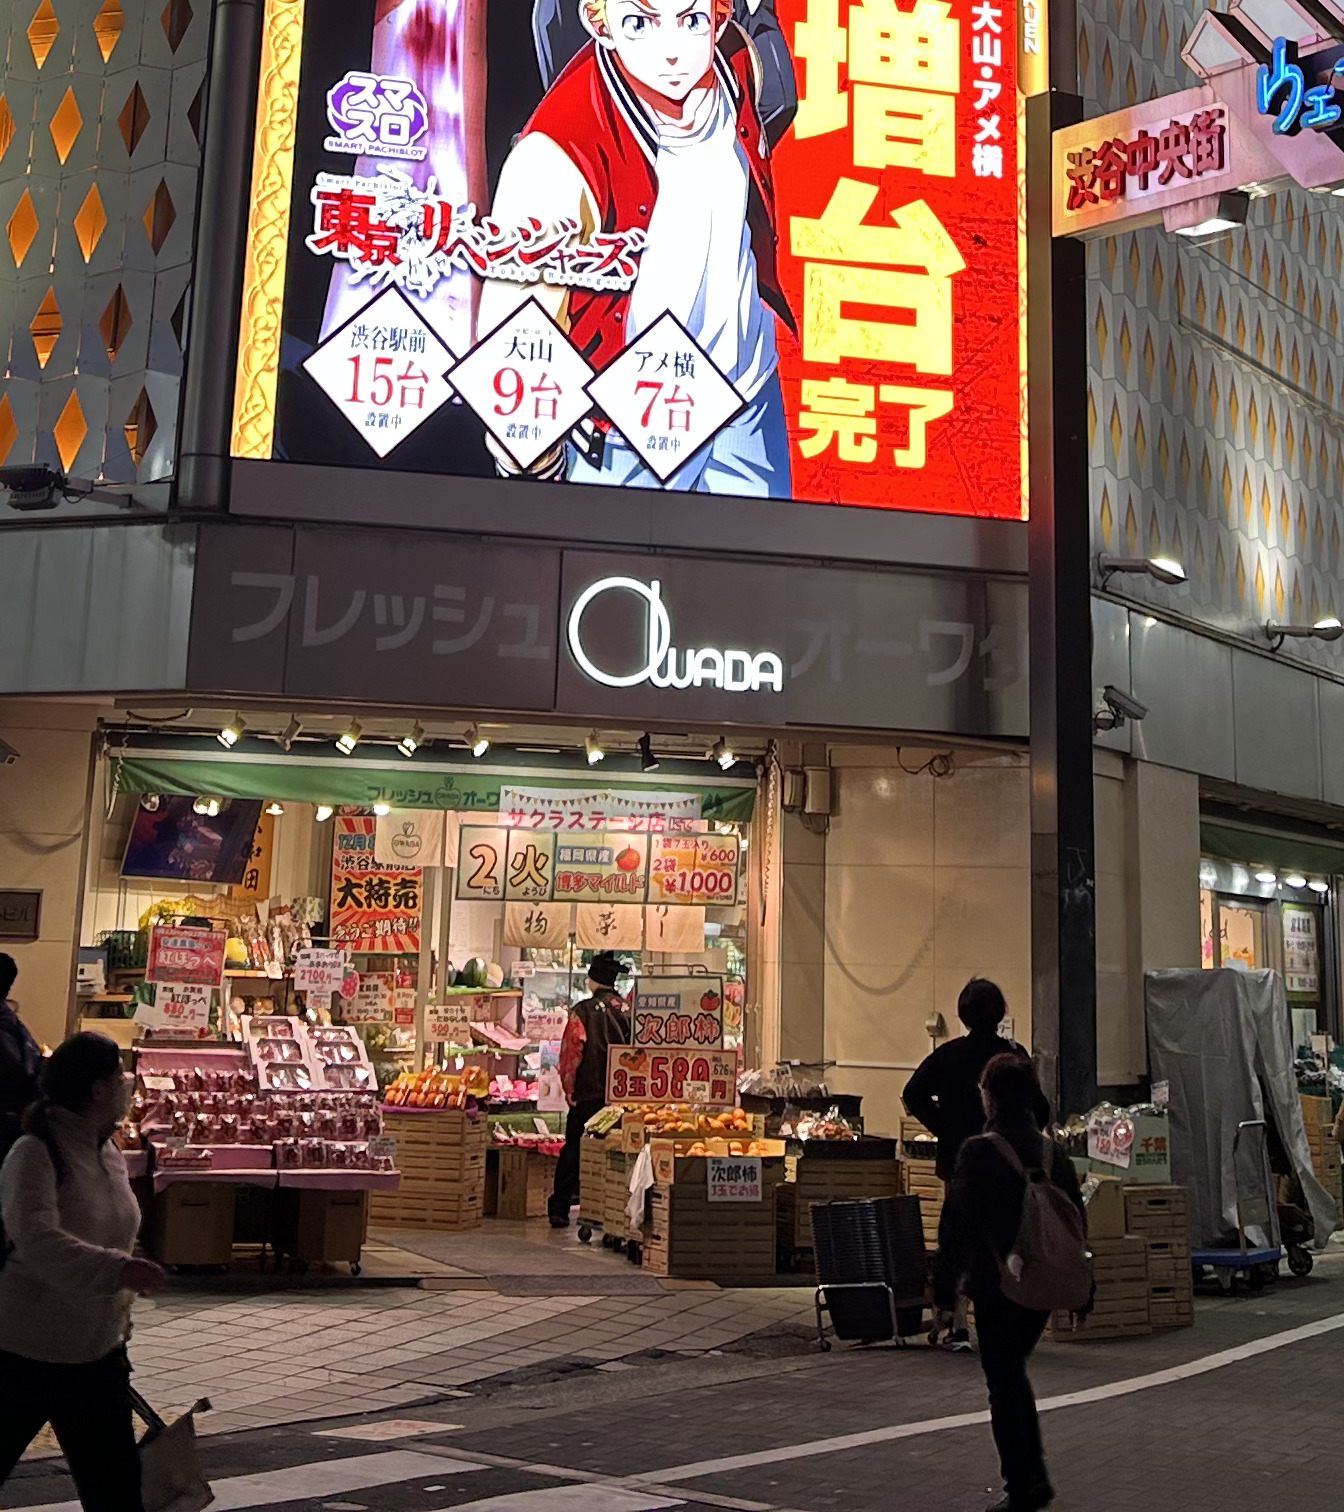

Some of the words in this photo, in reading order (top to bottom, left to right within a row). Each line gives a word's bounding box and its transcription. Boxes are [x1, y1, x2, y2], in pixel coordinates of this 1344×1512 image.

[1066, 108, 1231, 210] 渋谷中央街
[350, 324, 427, 356] 渋谷駅前
[504, 334, 554, 364] 大山
[635, 351, 696, 380] アメ横
[346, 354, 430, 410] 15台
[492, 366, 563, 421] 9台
[634, 379, 695, 433] 7台
[231, 571, 552, 660] フレッシュ
[367, 786, 434, 805] フレッシュ
[559, 848, 610, 864] 福岡県産
[336, 876, 419, 909] 大特売
[556, 872, 645, 894] 博多マイルド
[636, 1013, 721, 1044] 次郎柿
[711, 1165, 757, 1183] 次郎柿
